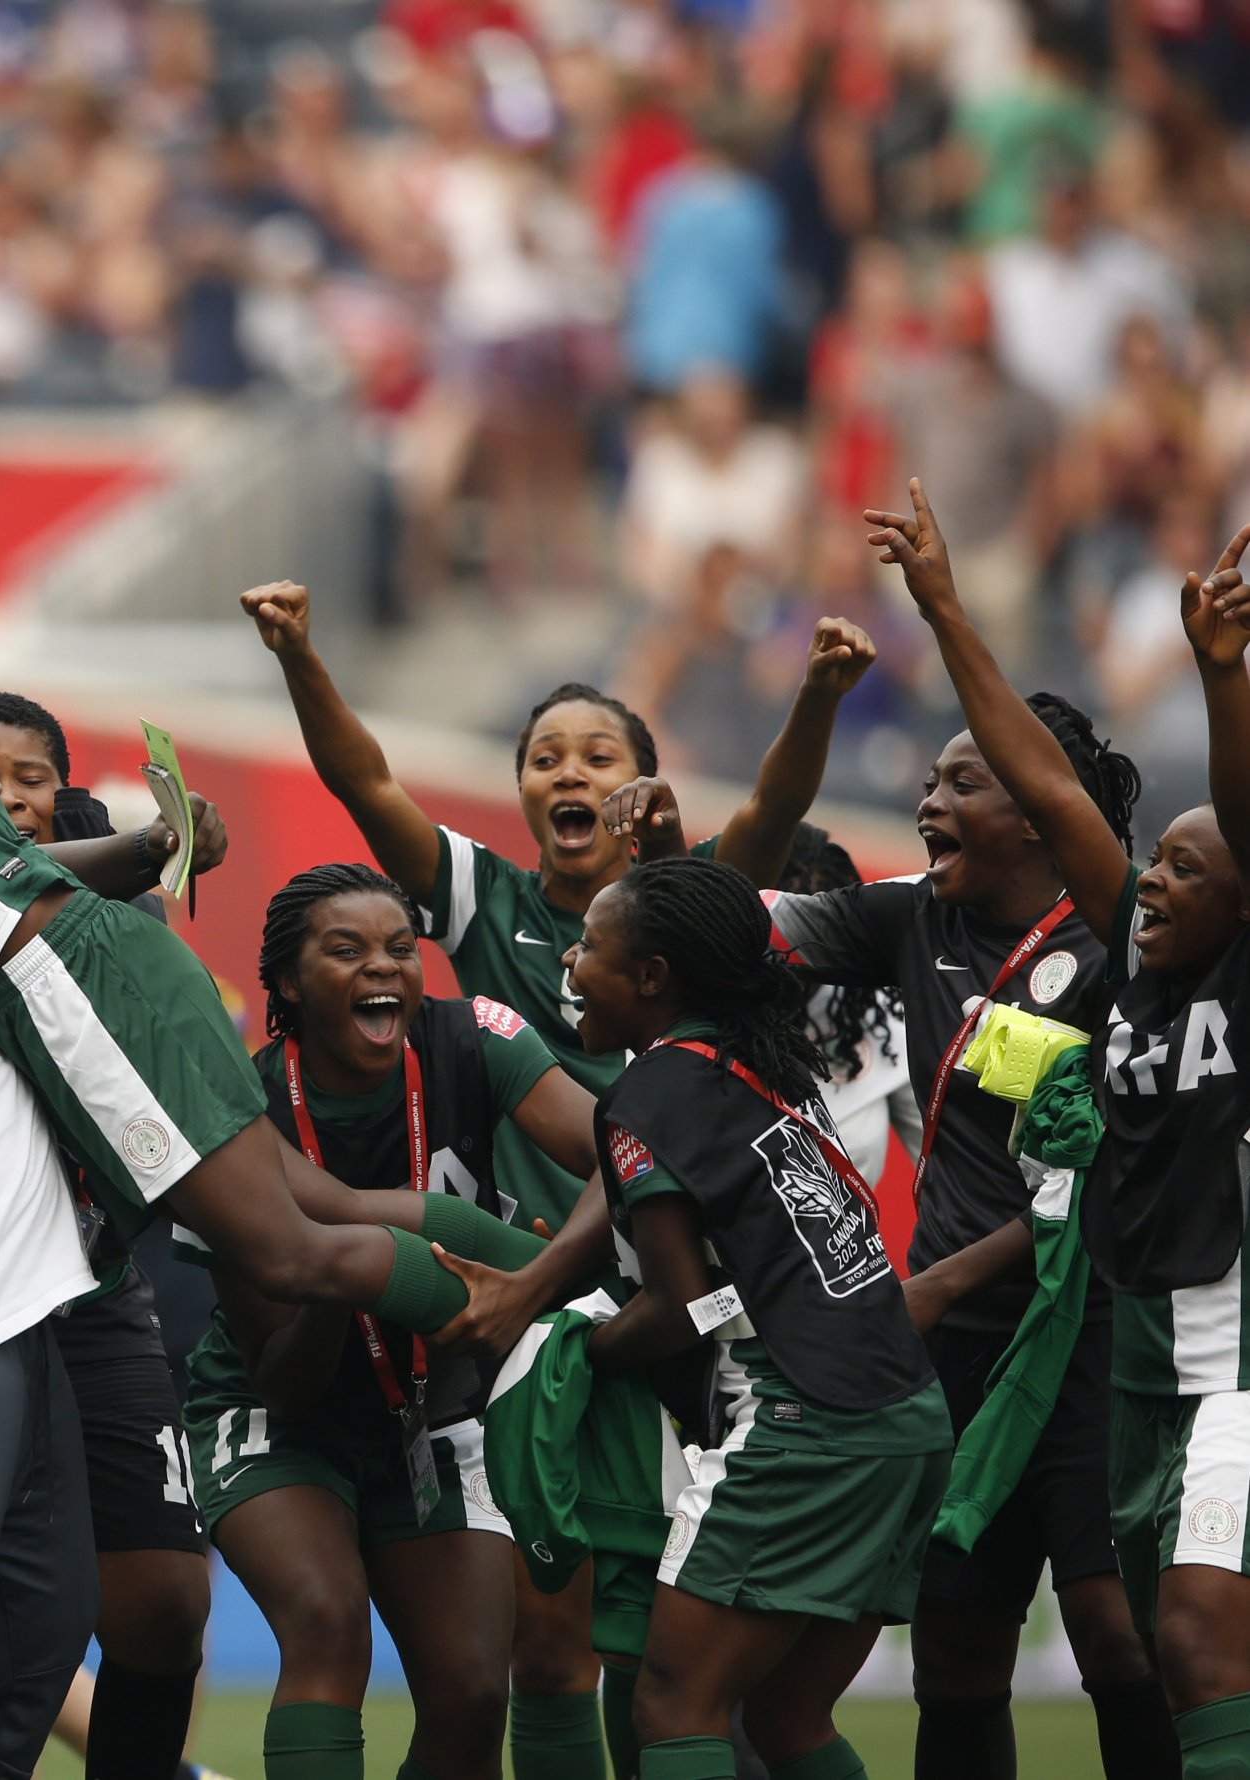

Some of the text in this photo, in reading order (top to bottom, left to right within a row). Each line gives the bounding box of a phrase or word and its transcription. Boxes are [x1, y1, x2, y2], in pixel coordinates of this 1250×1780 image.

[1008, 928, 1044, 968] FIFA.com
[945, 1043, 959, 1066] WORLD
[288, 1058, 300, 1106] FIFA.com
[934, 1077, 944, 1101] CANADA
[412, 1106, 420, 1137] WOMEN'S
[125, 1121, 167, 1165] NIGERIA FOOTBALL FEDERATION
[414, 1138, 422, 1163] WORLD
[618, 1143, 647, 1176] GOALS
[826, 1211, 862, 1254] CANADA
[834, 1239, 858, 1271] 2015
[363, 1313, 382, 1358] FIFA.com
[212, 1407, 270, 1474] 11
[1190, 1500, 1237, 1539] NIGERIA FOOTBALL FEDERATION
